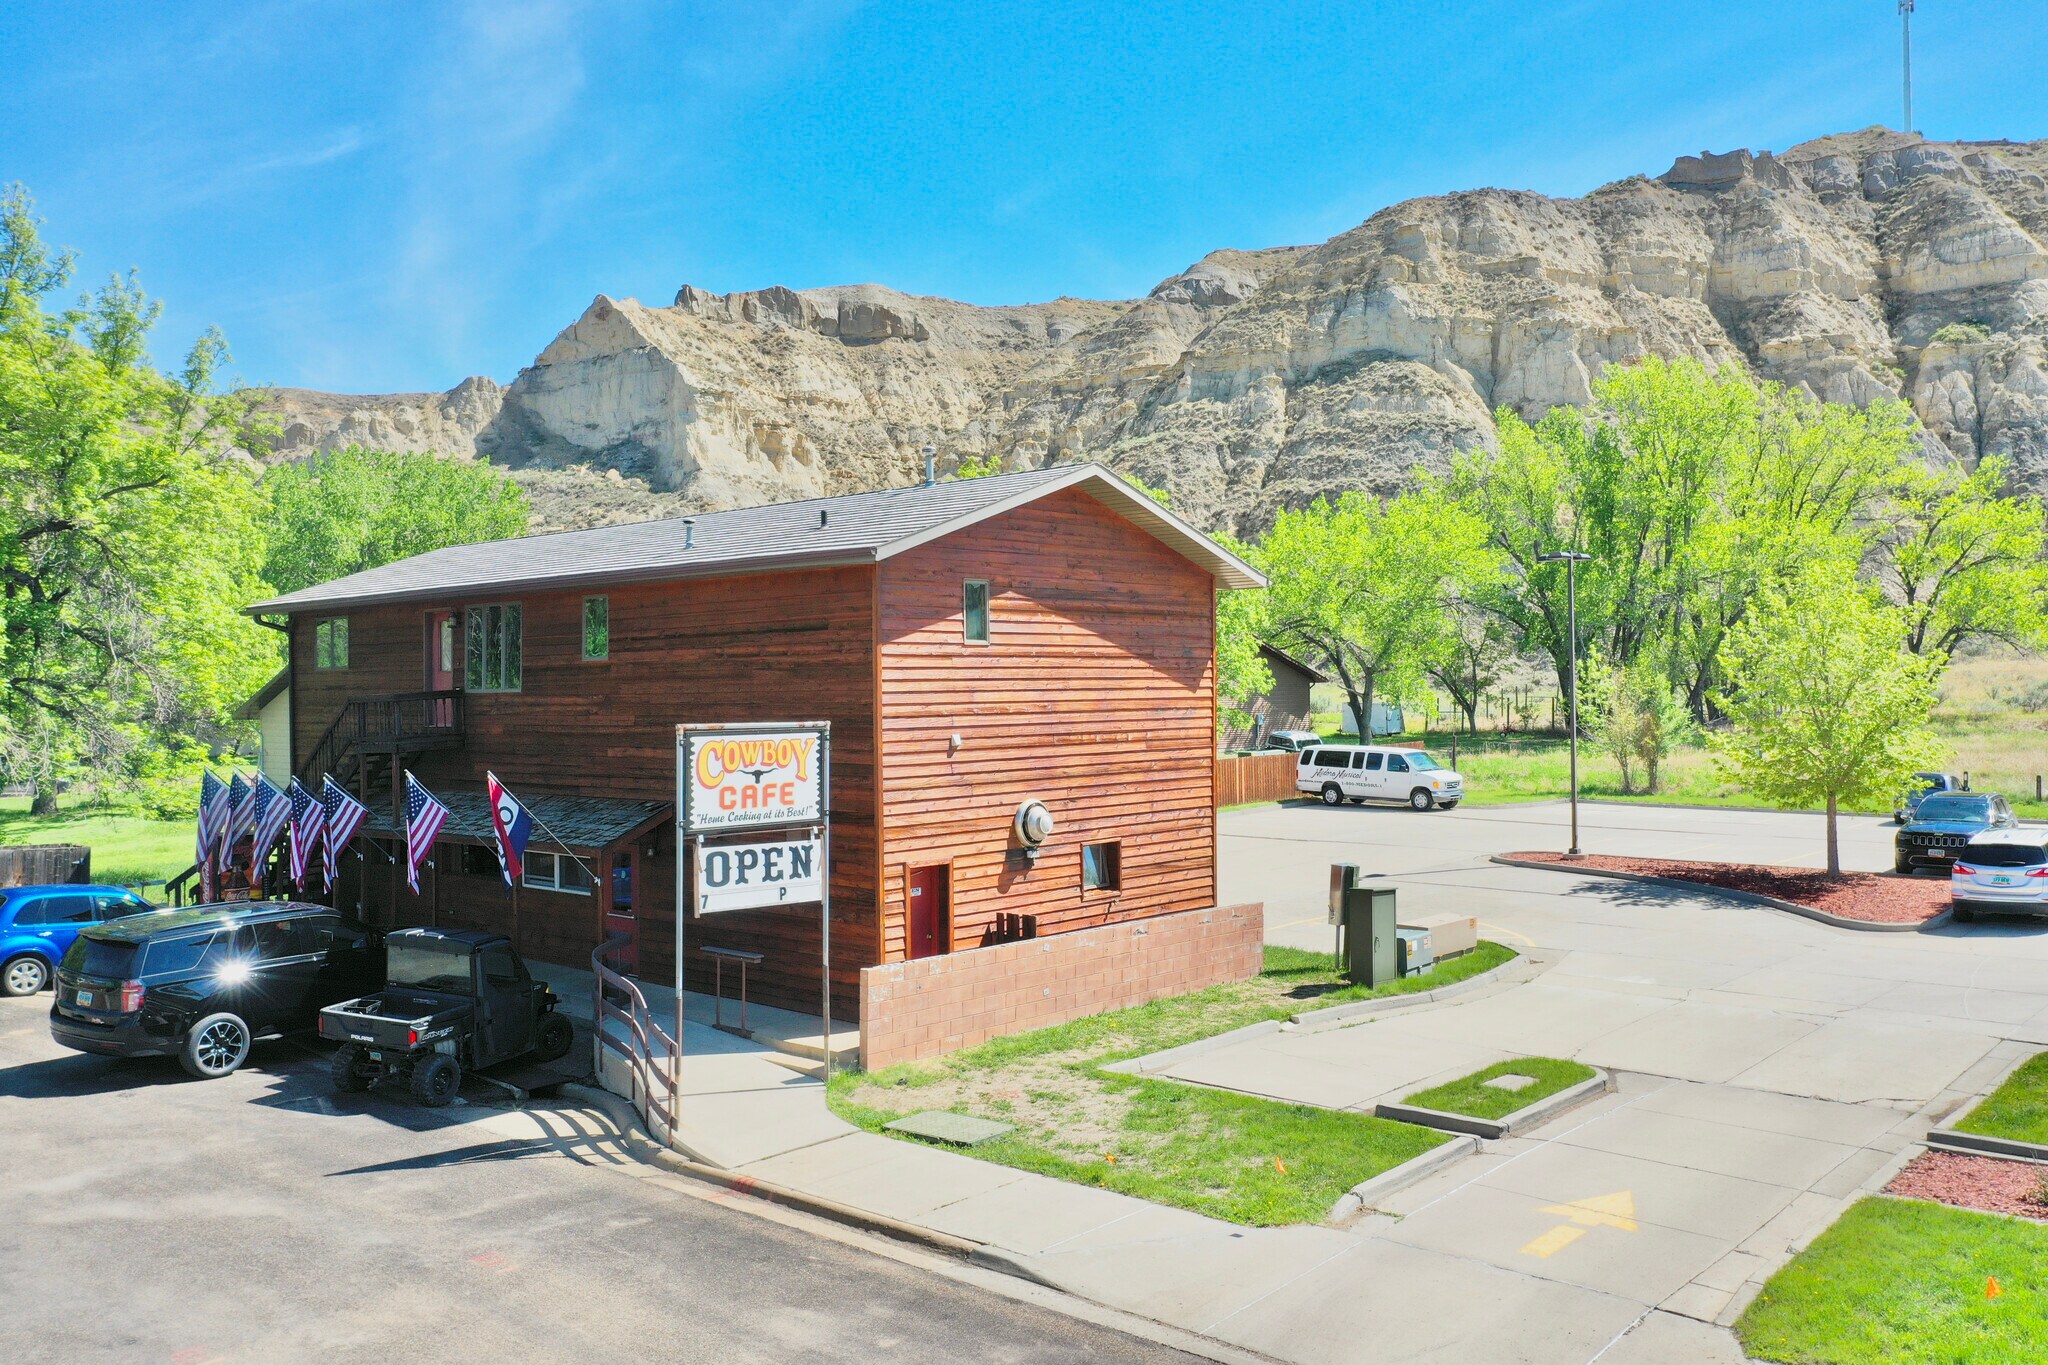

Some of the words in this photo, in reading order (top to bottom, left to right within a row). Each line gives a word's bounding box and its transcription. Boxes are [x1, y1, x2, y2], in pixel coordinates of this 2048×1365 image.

[696, 738, 815, 789] COWBOY
[1333, 770, 1364, 780] Musical
[719, 782, 795, 810] CAFE
[727, 811, 761, 823] Cooking
[763, 809, 773, 819] at
[774, 808, 785, 818] its
[704, 844, 814, 888] OPEN
[701, 895, 709, 910] 7
[779, 887, 787, 901] P
[350, 1034, 374, 1042] POLARIS
